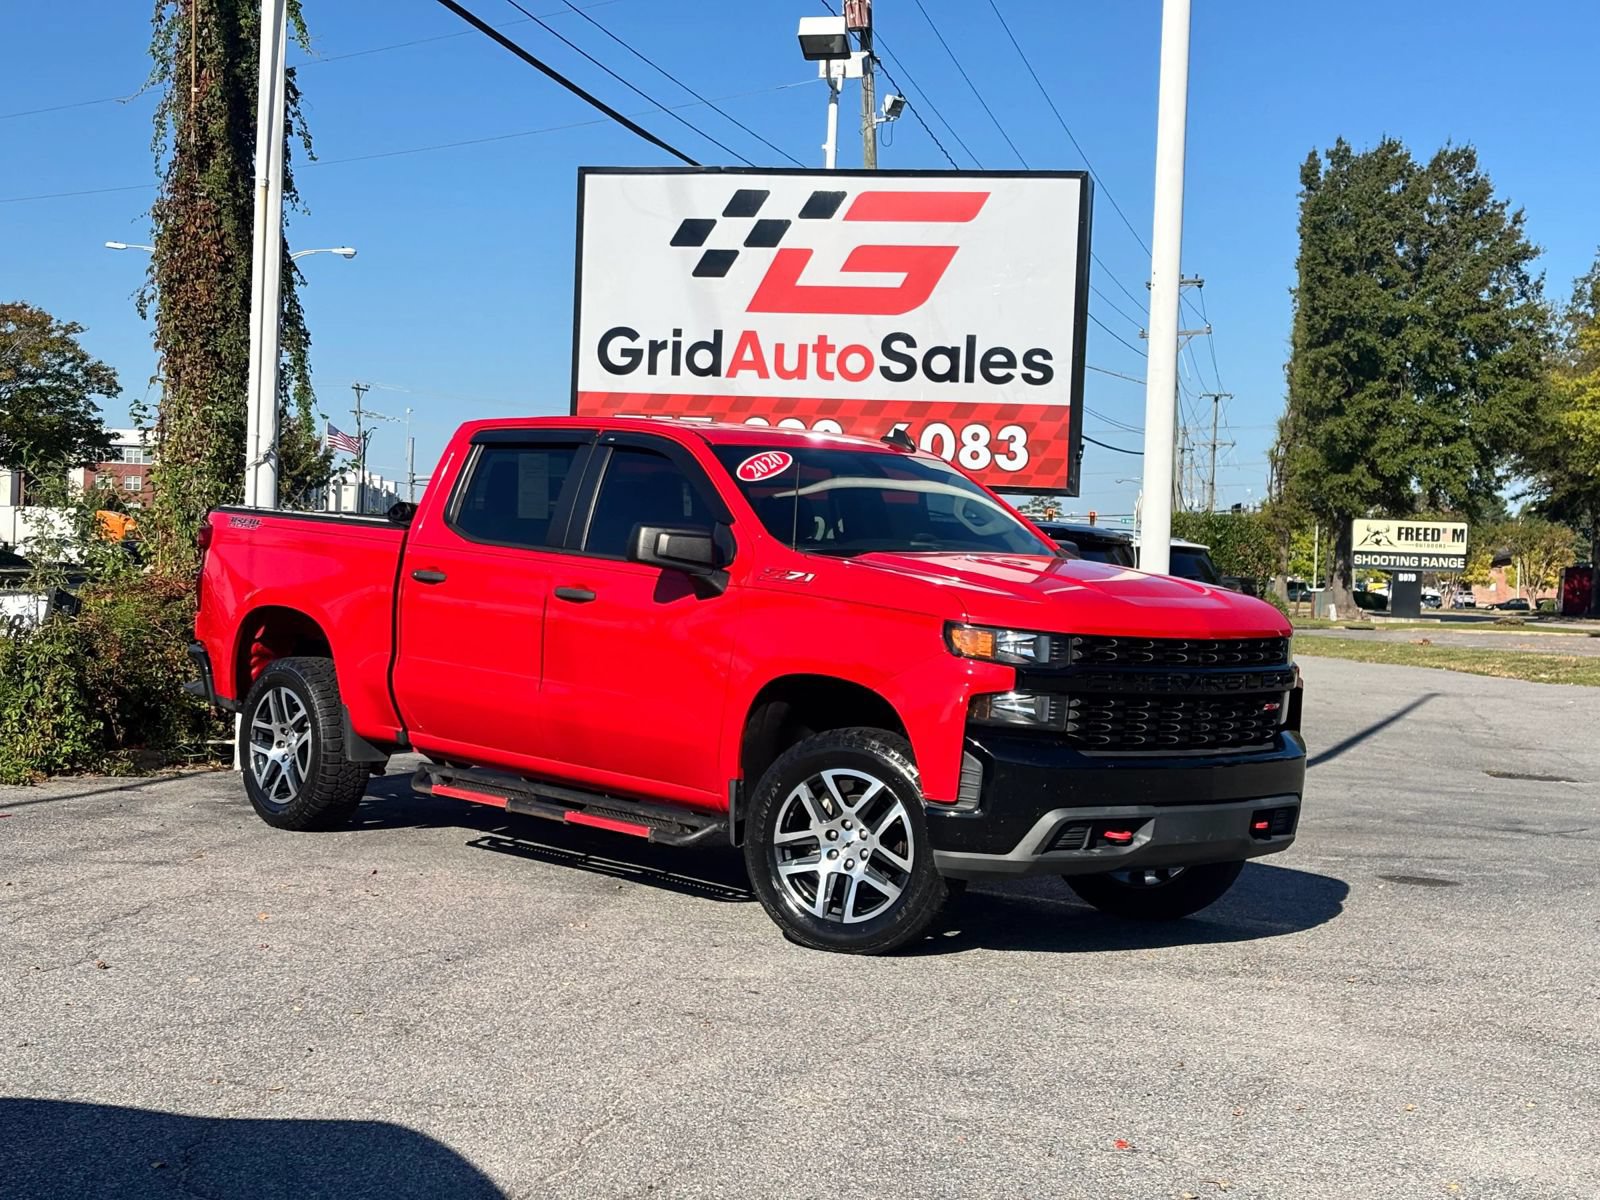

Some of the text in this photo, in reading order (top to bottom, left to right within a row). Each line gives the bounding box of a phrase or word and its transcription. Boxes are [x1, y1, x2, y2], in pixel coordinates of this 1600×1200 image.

[746, 453, 784, 478] 2020
[1397, 526, 1465, 543] FREEDM
[1354, 554, 1466, 568] SHOOTING RANGE
[757, 567, 817, 584] Z71
